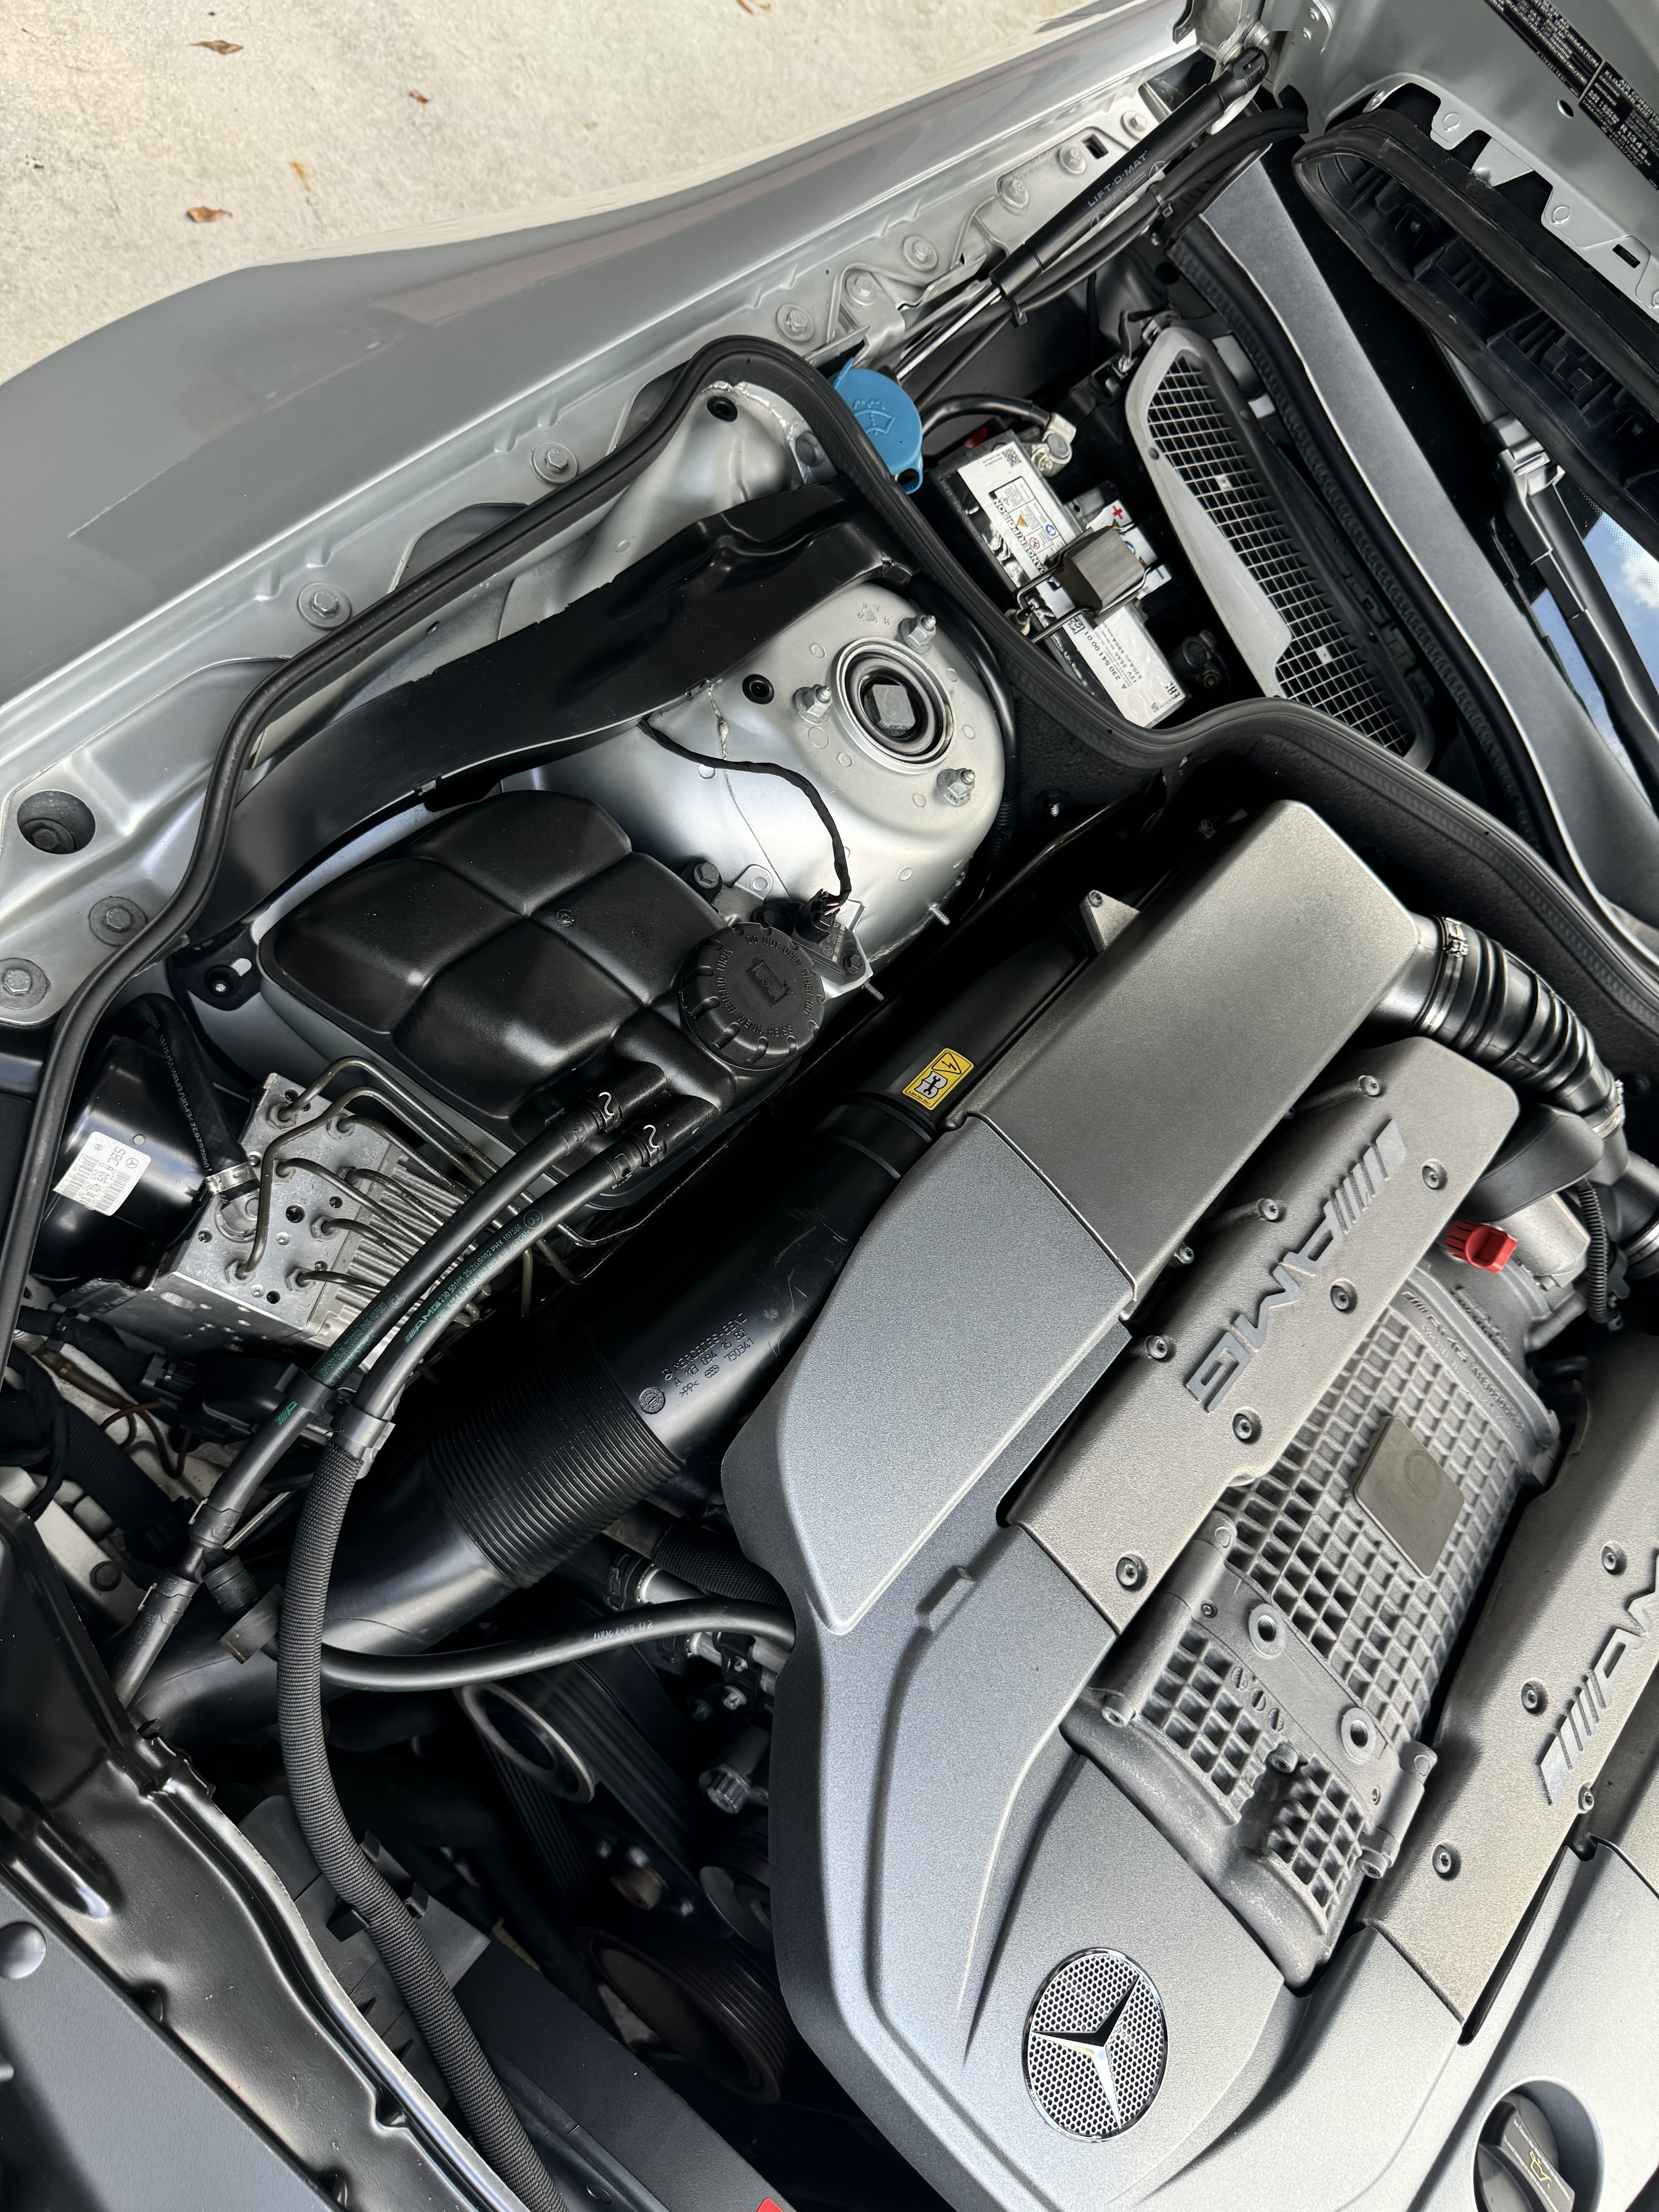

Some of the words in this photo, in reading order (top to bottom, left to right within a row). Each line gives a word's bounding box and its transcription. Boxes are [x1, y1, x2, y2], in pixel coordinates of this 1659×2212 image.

[1554, 19, 1600, 67] INFORMATION
[1604, 68, 1650, 121] KLIMAANLAGE
[1619, 78, 1632, 92] AIR
[993, 493, 1046, 577] DANGER/POISON
[1084, 630, 1093, 641] 01
[1090, 640, 1100, 652] 00
[1111, 636, 1125, 655] 480A
[1098, 651, 1110, 666] 541
[1114, 650, 1127, 669] 35Ah
[1108, 665, 1121, 681] 230
[1127, 670, 1137, 684] 12V
[1128, 661, 1142, 681] 520A
[747, 935, 758, 944] DO
[763, 936, 780, 949] NOT
[783, 946, 802, 967] OPEN
[801, 969, 814, 996] WHEN
[803, 999, 814, 1017] HOT
[737, 1013, 763, 1034] WENN
[768, 1025, 793, 1037] HEISS
[106, 1145, 127, 1168] SBC
[96, 1170, 110, 1184] 005
[104, 1164, 114, 1173] A
[438, 1290, 451, 1303] 230
[490, 1238, 504, 1252] PHX
[435, 1307, 449, 1321] DBL
[672, 1376, 683, 1388] A
[700, 1349, 719, 1367] 094
[719, 1338, 733, 1352] 16
[733, 1327, 747, 1342] 82
[678, 1378, 700, 1399] >PP<
[723, 1336, 755, 1365] 750341
